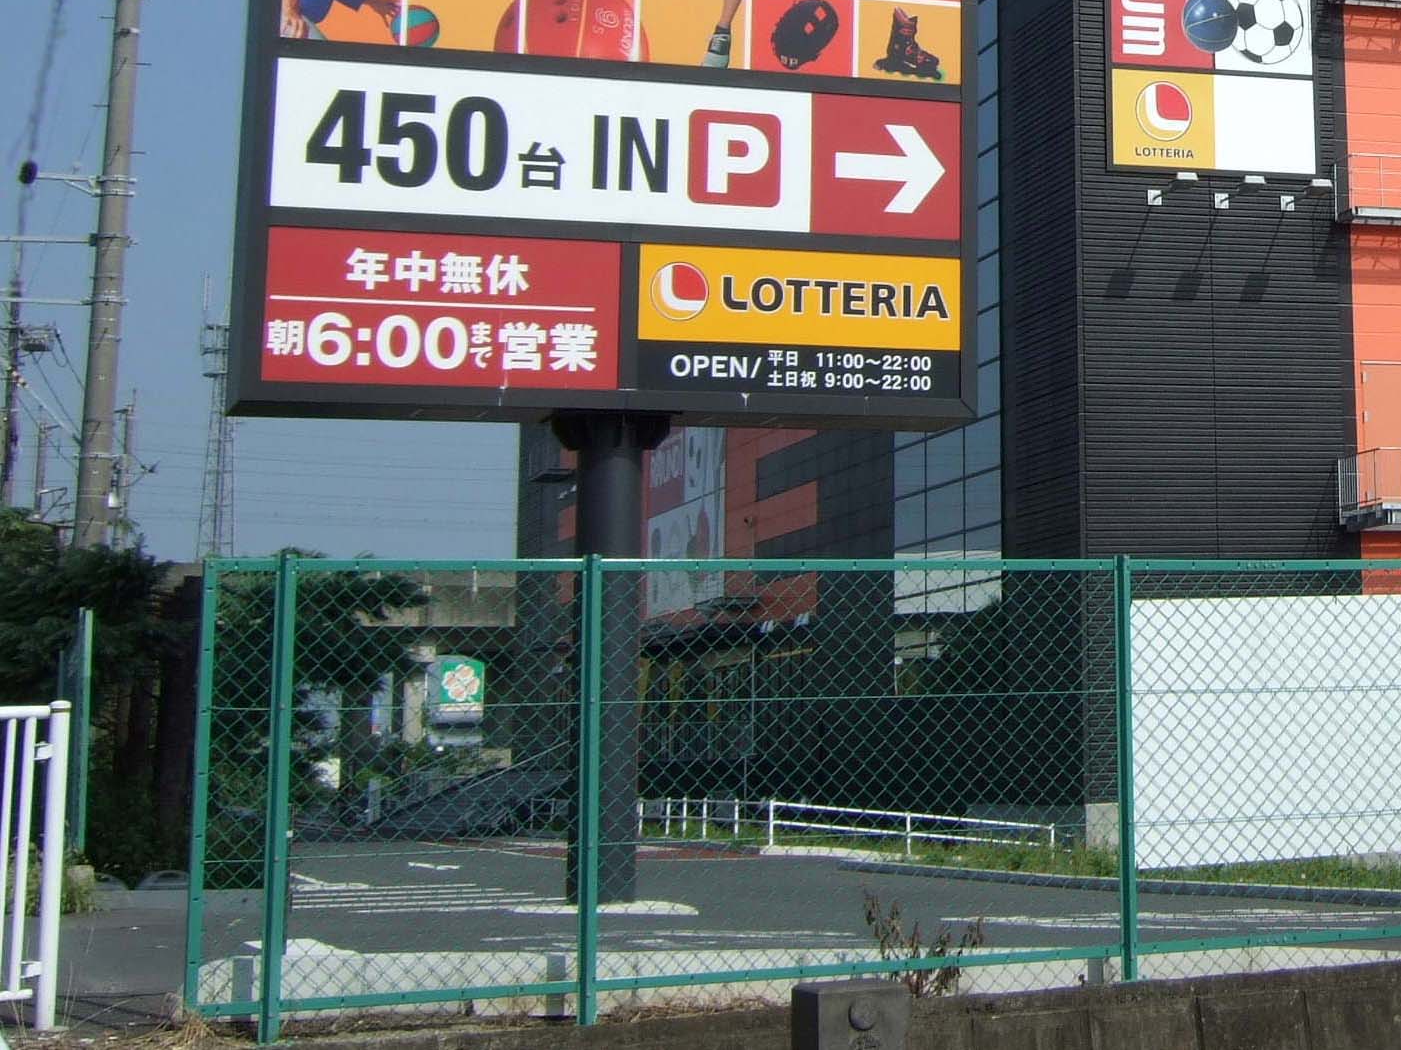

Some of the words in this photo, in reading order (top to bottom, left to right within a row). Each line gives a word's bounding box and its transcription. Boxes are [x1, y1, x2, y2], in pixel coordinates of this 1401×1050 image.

[592, 115, 670, 193] IN
[706, 122, 770, 193] P
[1135, 147, 1194, 159] LOTTERIA
[346, 247, 530, 296] 年中無休
[721, 275, 949, 319] LOTTERIA
[767, 350, 798, 368] 平日
[767, 370, 817, 389] 土日祝
